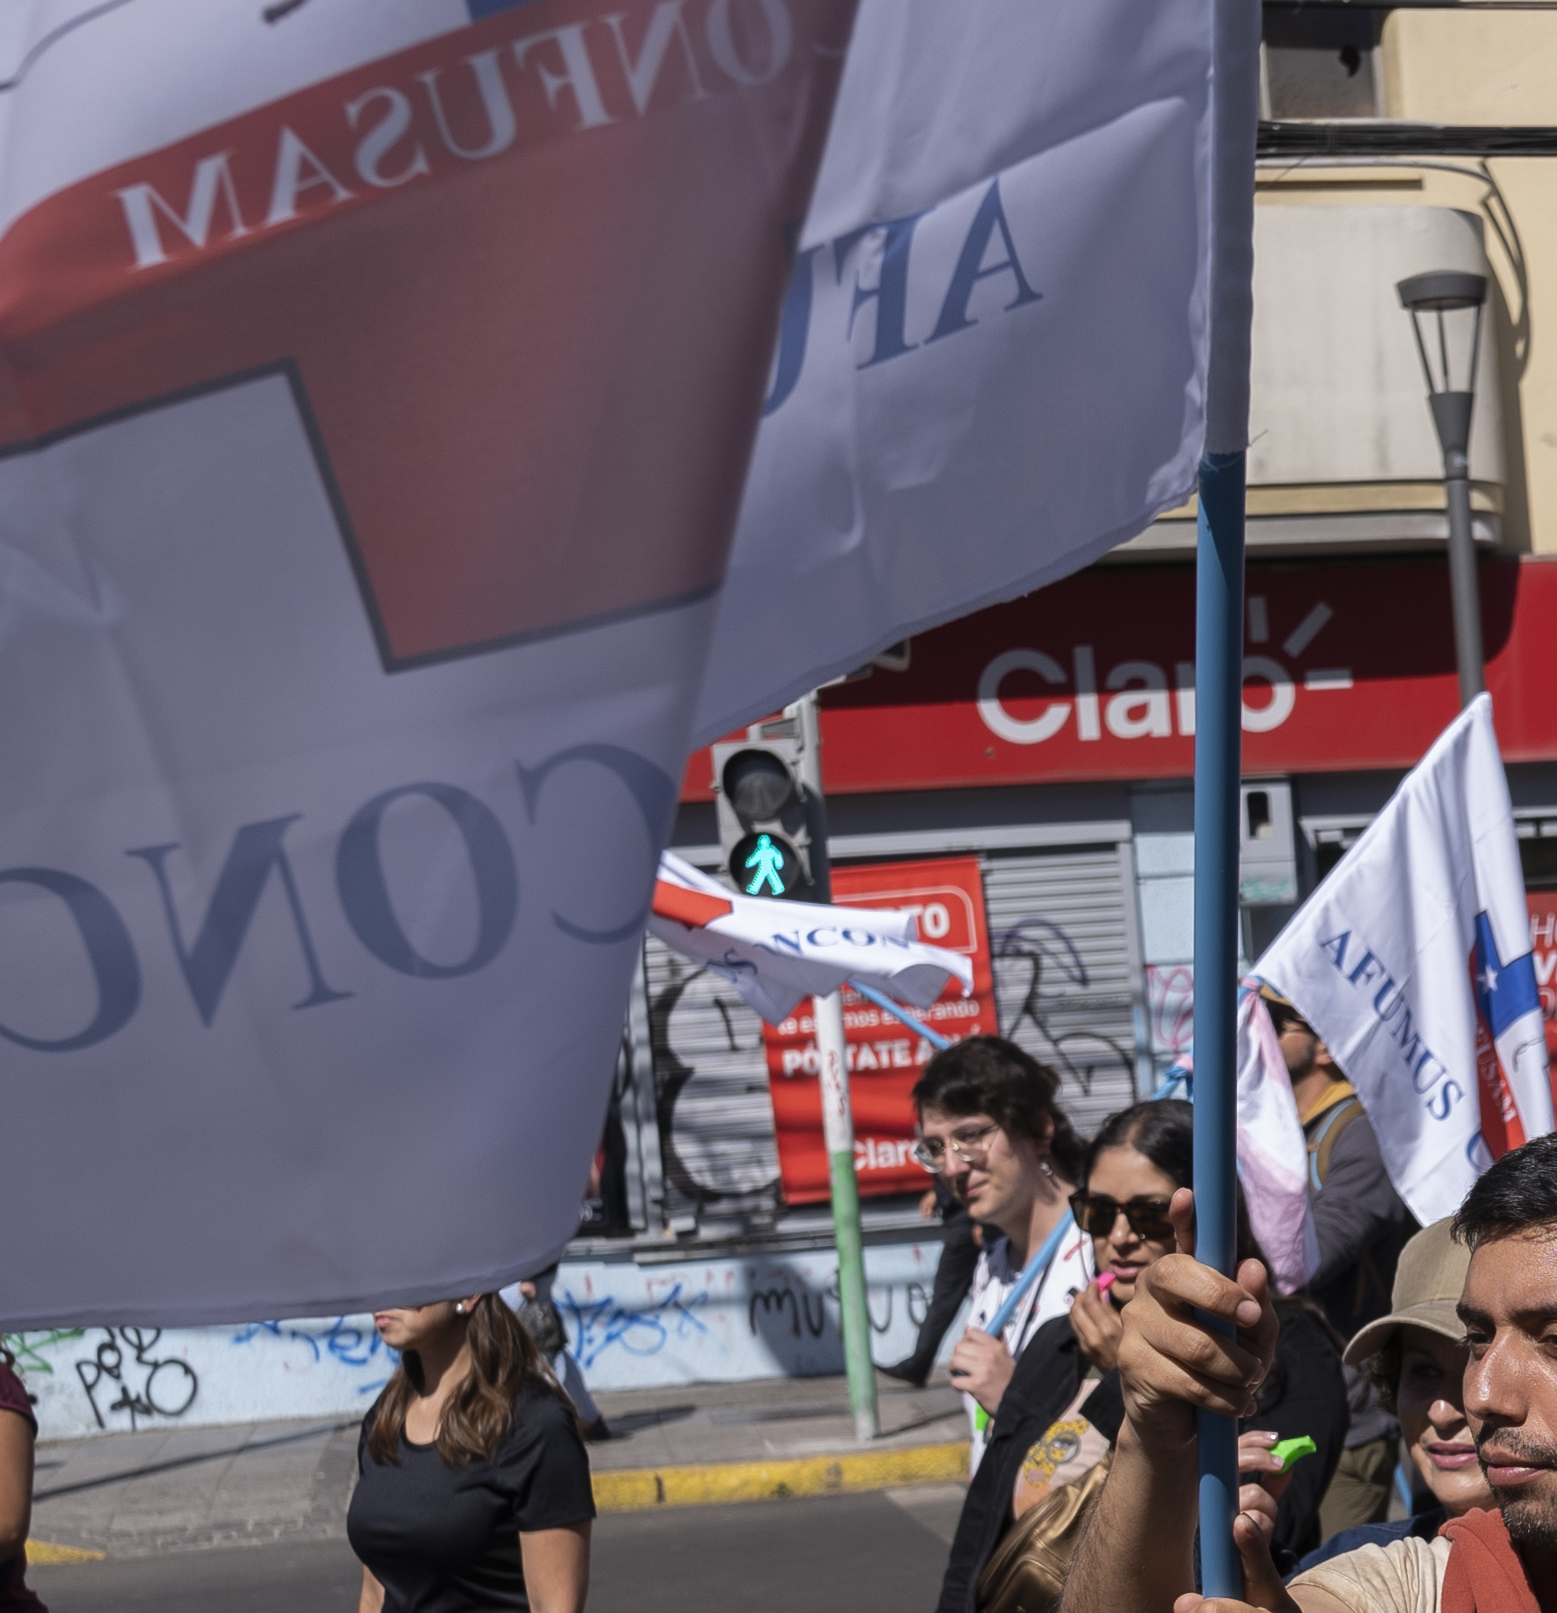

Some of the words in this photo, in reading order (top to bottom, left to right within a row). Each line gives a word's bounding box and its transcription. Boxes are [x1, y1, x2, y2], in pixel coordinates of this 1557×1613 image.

[800, 1007, 880, 1032] esmos
[1320, 930, 1465, 1121] AFUMUS
[782, 1038, 912, 1077] PÓTATE
[854, 1137, 921, 1171] Clar
